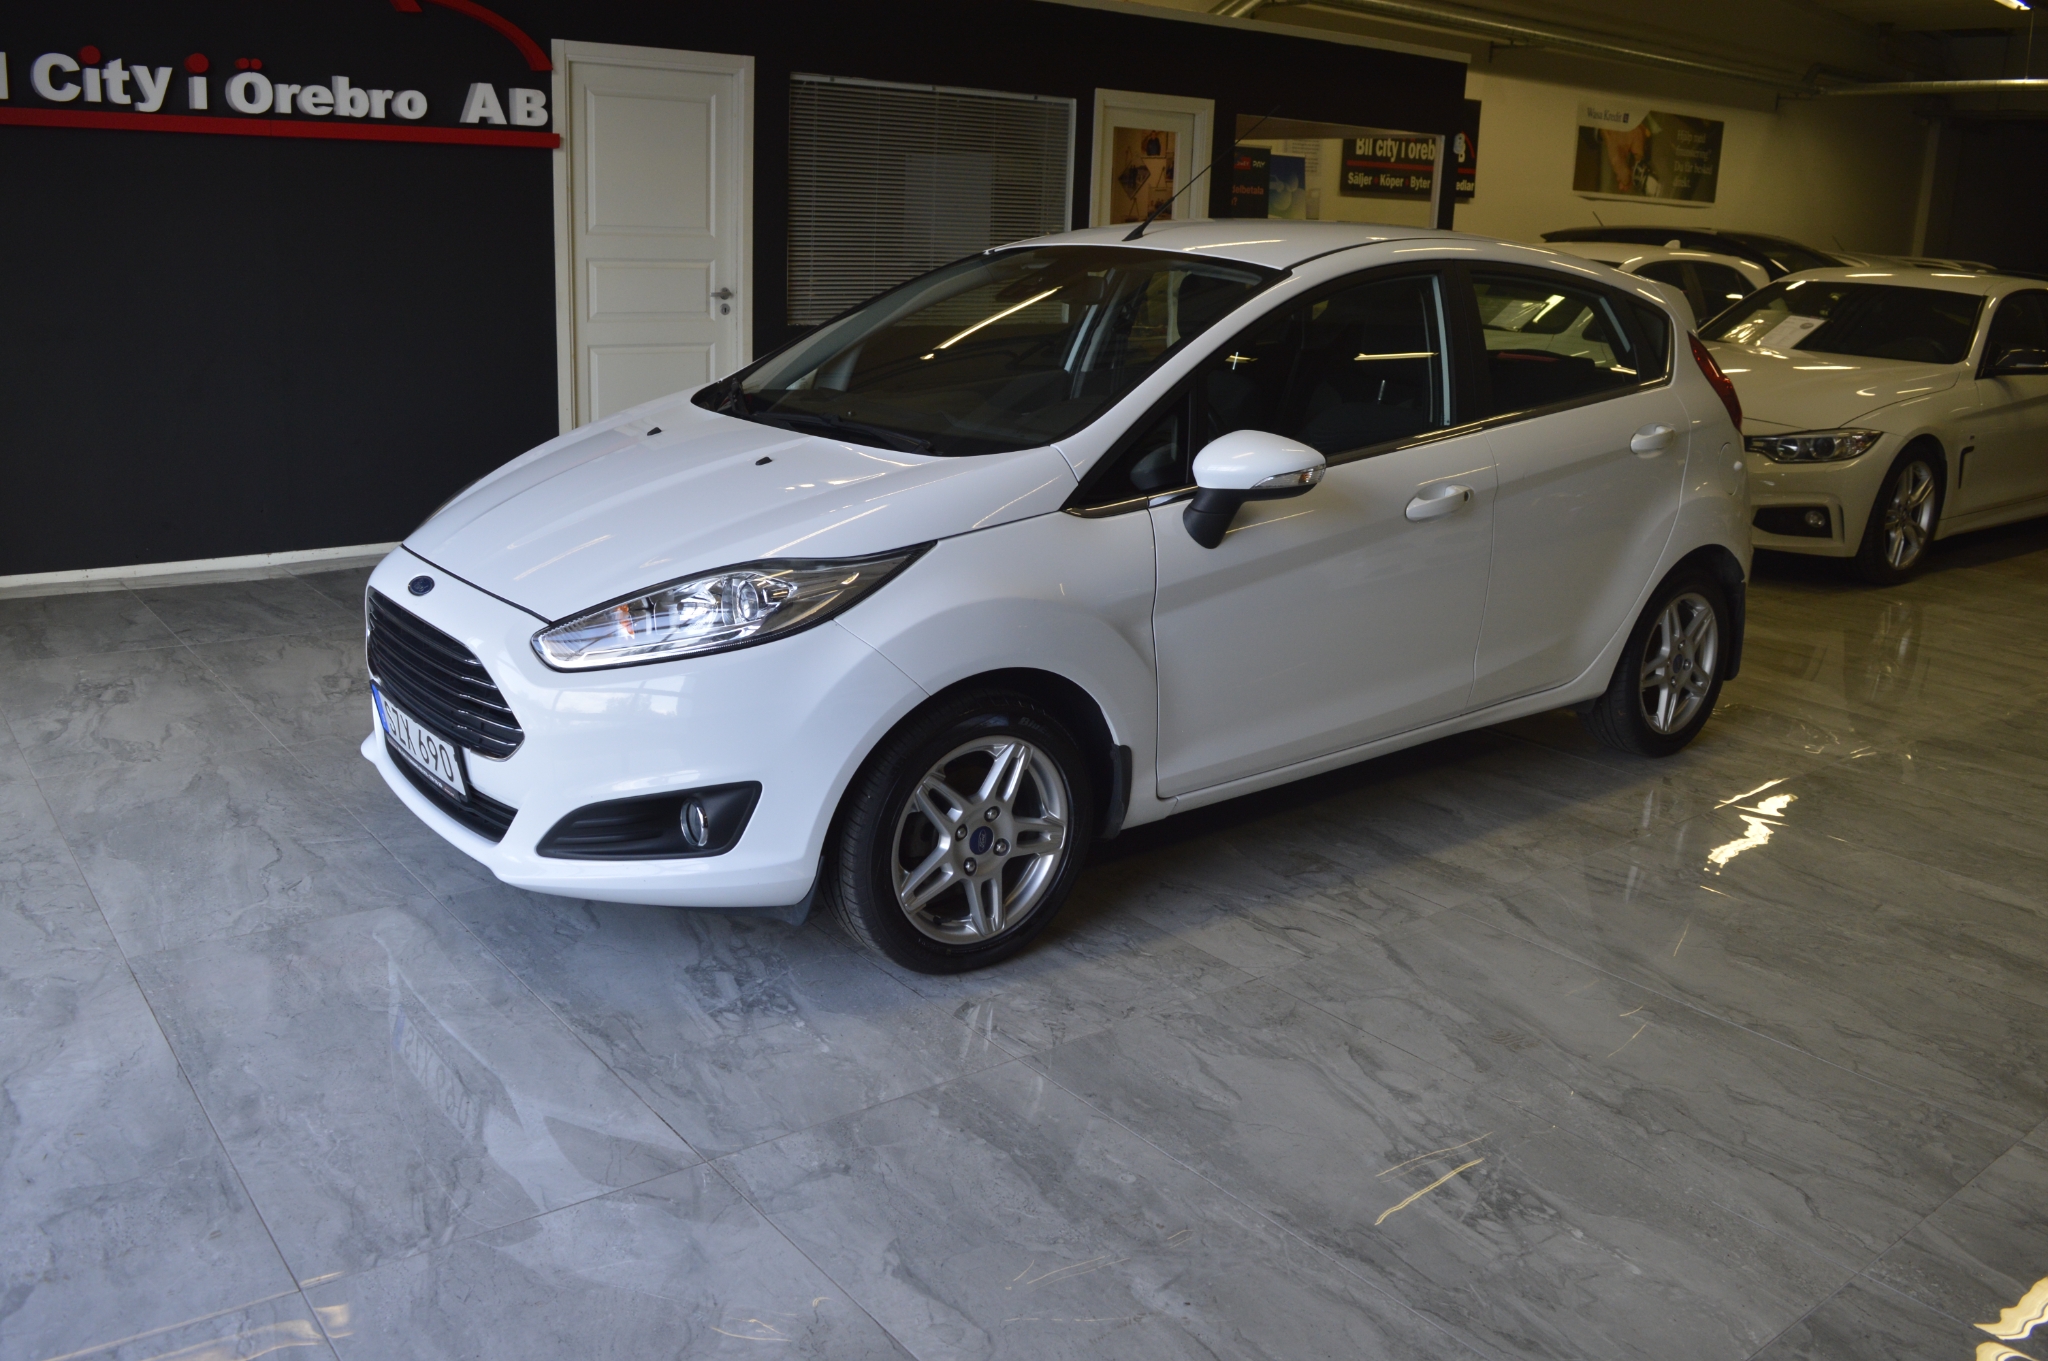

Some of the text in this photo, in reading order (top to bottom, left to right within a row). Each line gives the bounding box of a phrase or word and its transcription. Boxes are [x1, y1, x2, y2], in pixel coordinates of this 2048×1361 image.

[30, 45, 172, 112] City
[184, 53, 209, 110] i
[225, 57, 428, 120] Örebro
[459, 82, 549, 127] AB
[1348, 172, 1372, 187] Säljer
[1380, 174, 1404, 189] Köper
[1410, 176, 1431, 191] Byter
[385, 701, 417, 755] SZX
[418, 729, 454, 782] 690
